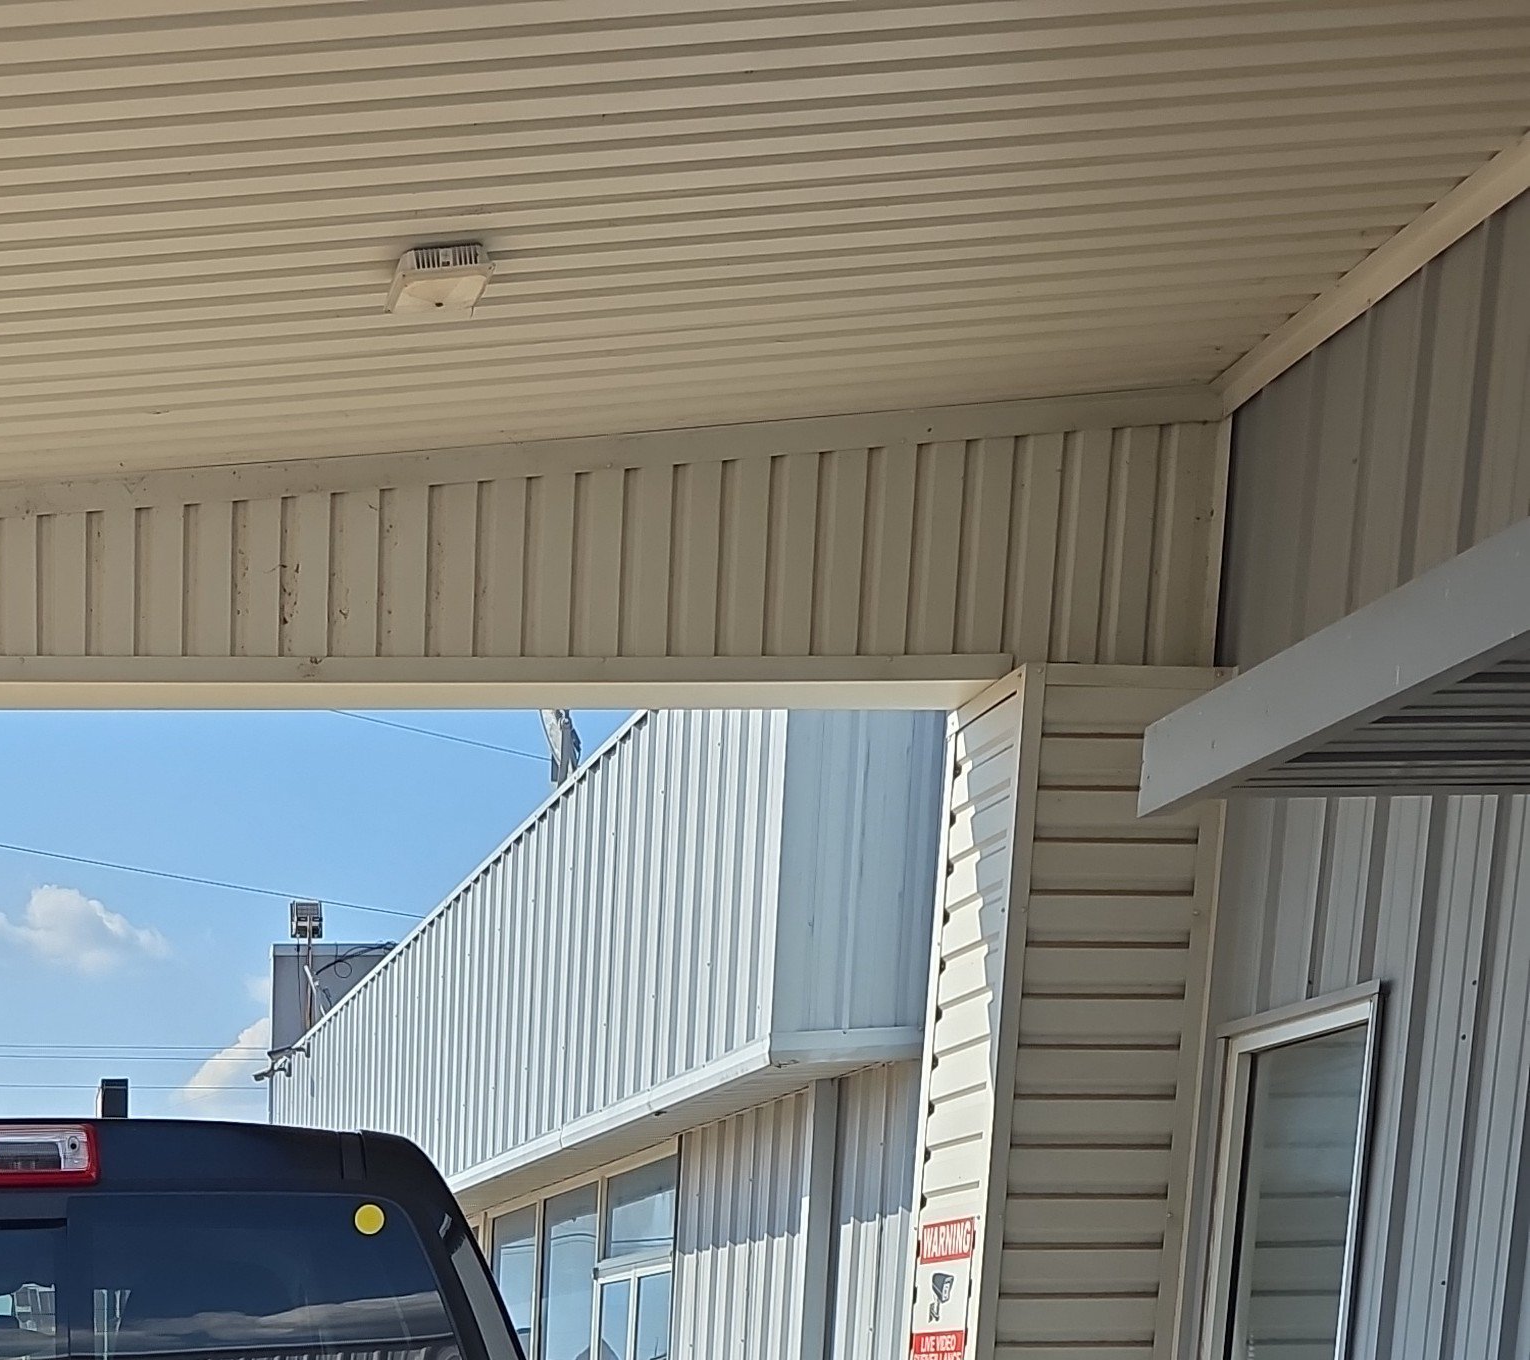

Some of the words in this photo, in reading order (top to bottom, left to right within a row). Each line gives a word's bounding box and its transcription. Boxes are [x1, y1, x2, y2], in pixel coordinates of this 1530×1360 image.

[923, 1220, 971, 1259] WARNING
[921, 1336, 936, 1352] LIVE
[936, 1334, 957, 1351] VIDEO
